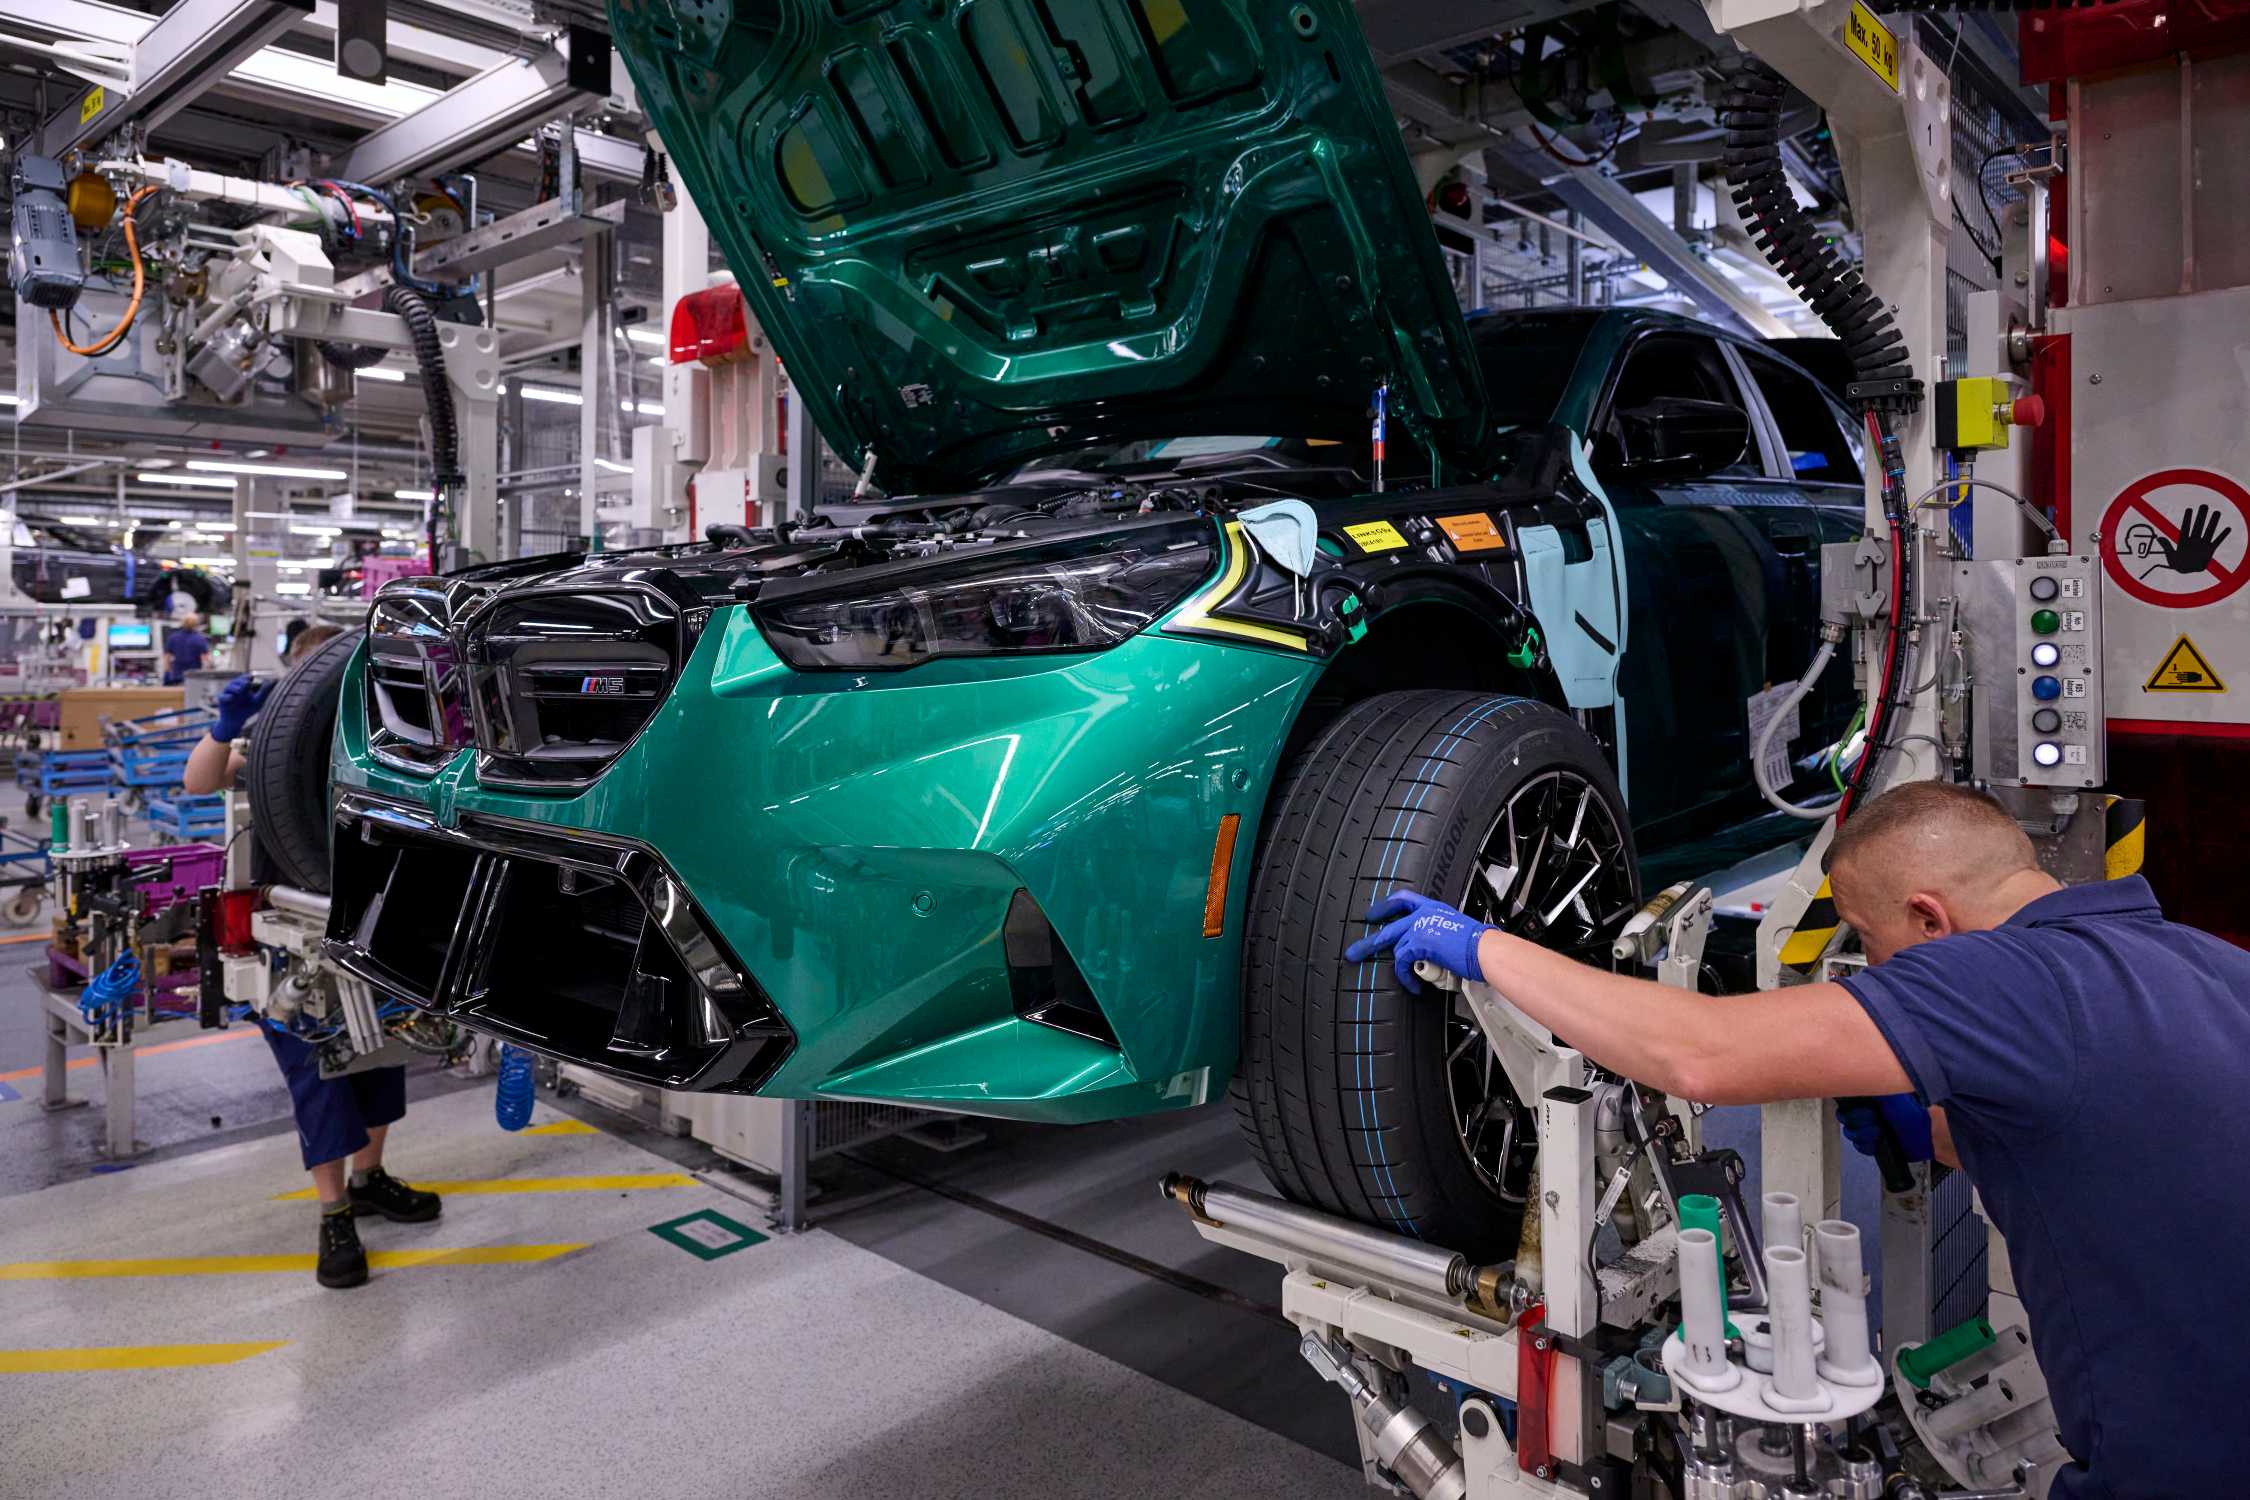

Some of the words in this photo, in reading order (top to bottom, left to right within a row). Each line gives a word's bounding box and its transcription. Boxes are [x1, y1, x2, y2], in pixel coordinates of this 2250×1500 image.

[1872, 31, 1881, 59] 50
[1884, 43, 1893, 77] kg
[1927, 122, 1932, 147] 1
[588, 676, 624, 694] M5
